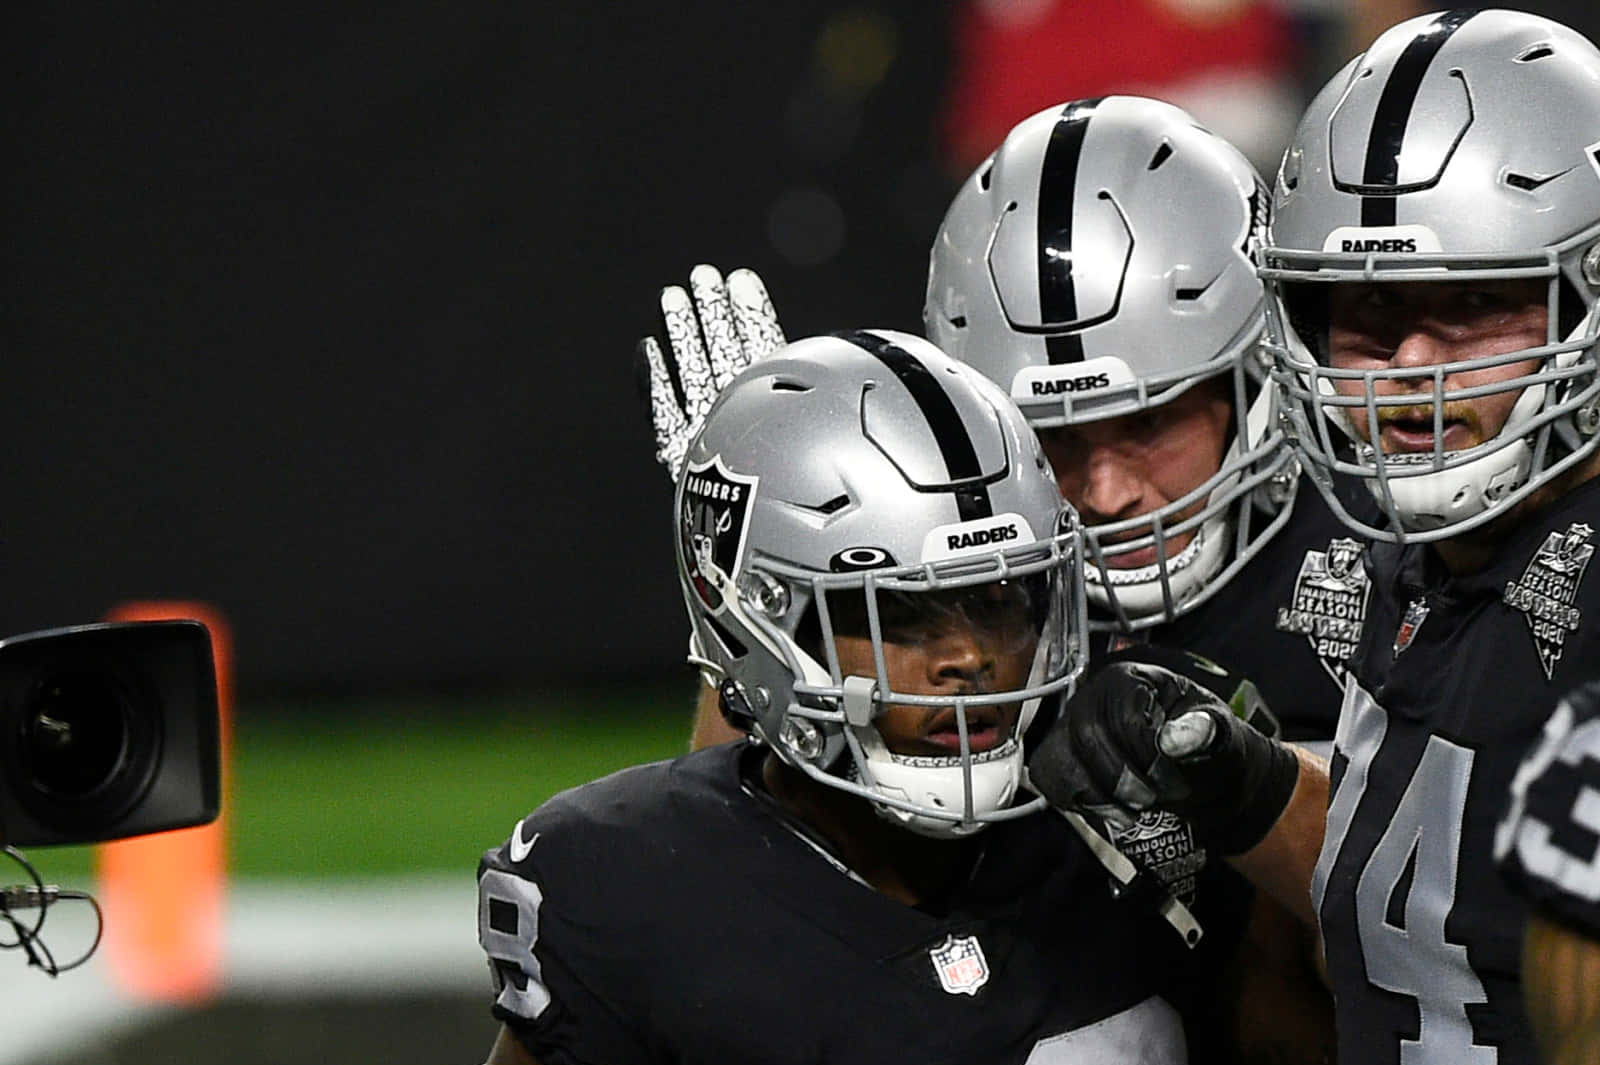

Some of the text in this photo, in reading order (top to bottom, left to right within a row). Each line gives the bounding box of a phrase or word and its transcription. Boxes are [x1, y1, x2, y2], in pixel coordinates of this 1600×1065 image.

[1342, 238, 1417, 253] RAIDERS
[1031, 372, 1110, 395] RAIDERS
[687, 475, 741, 502] RAIDERS
[947, 523, 1018, 550] RAIDERS
[1525, 574, 1573, 603] SEASON
[1297, 597, 1361, 620] SEASON
[1533, 619, 1566, 645] 2020
